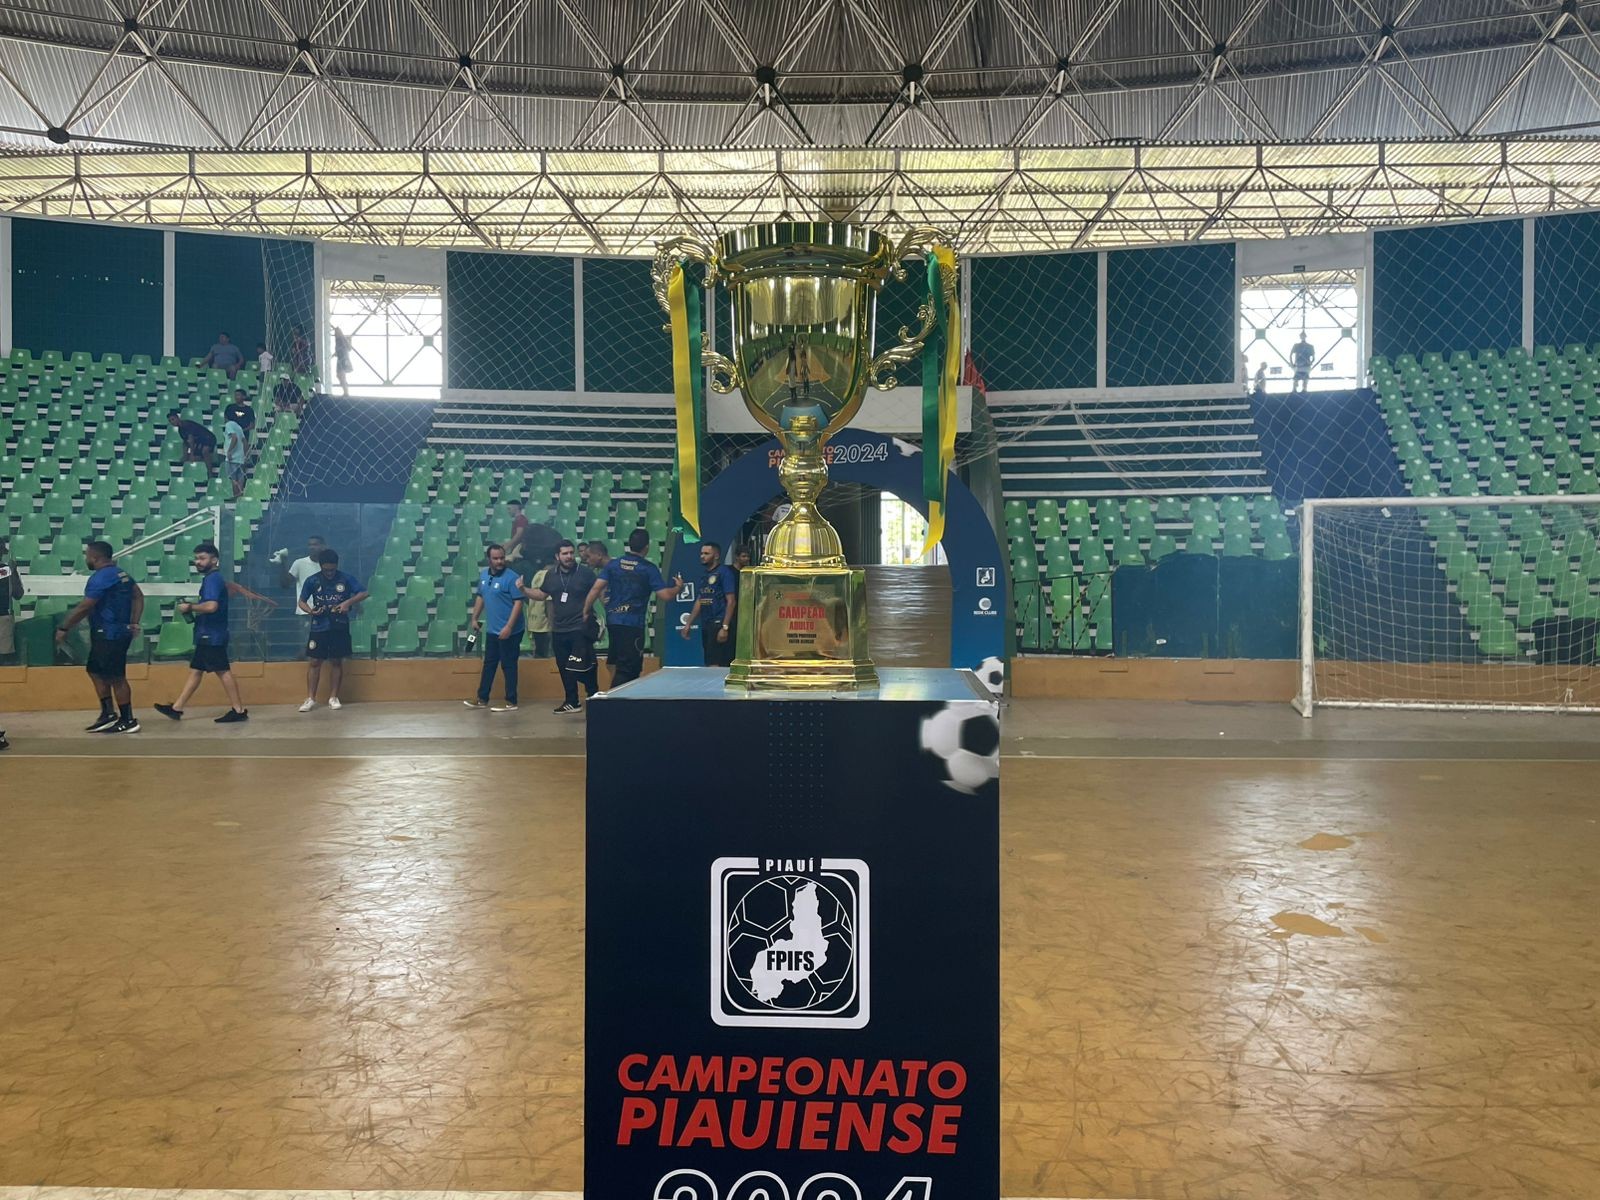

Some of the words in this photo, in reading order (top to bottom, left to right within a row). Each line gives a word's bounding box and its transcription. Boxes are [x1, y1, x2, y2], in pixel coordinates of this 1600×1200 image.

[833, 442, 889, 464] 2024
[766, 858, 814, 873] PIAUÍ
[766, 951, 815, 971] FPIFS
[617, 1053, 968, 1099] CAMPEONATO
[616, 1097, 963, 1154] PIAUIENSE
